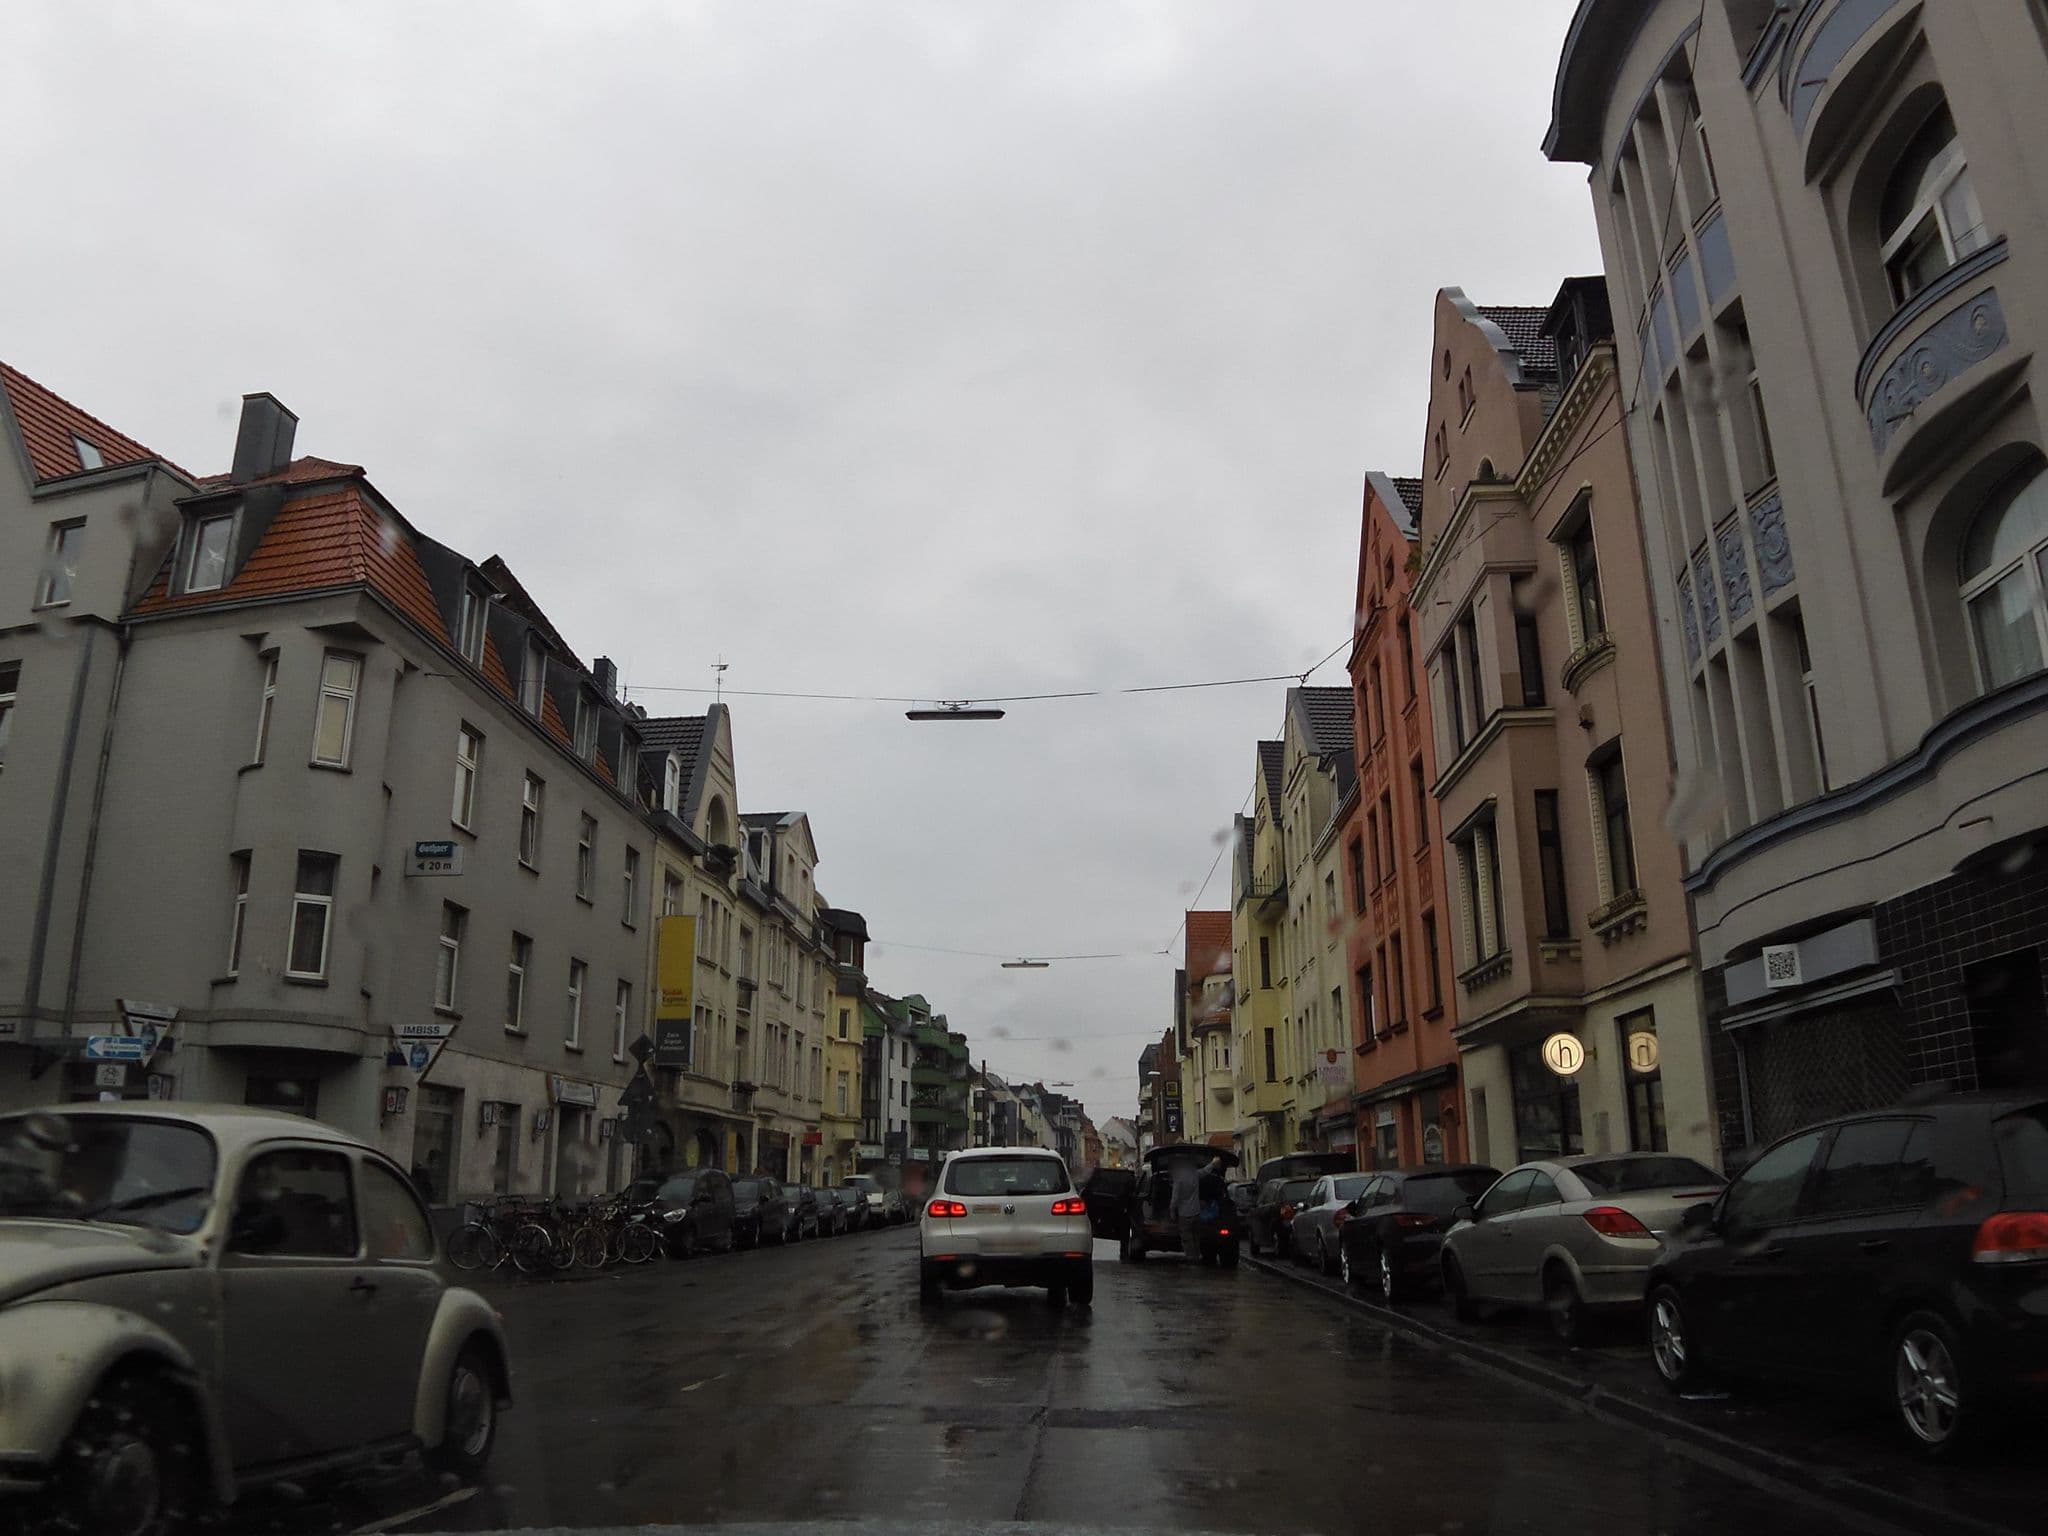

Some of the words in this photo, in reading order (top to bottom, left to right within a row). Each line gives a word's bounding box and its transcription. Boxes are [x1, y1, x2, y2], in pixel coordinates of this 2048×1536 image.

[428, 861, 441, 871] 20
[443, 862, 452, 870] m
[403, 1025, 441, 1035] IMBISS
